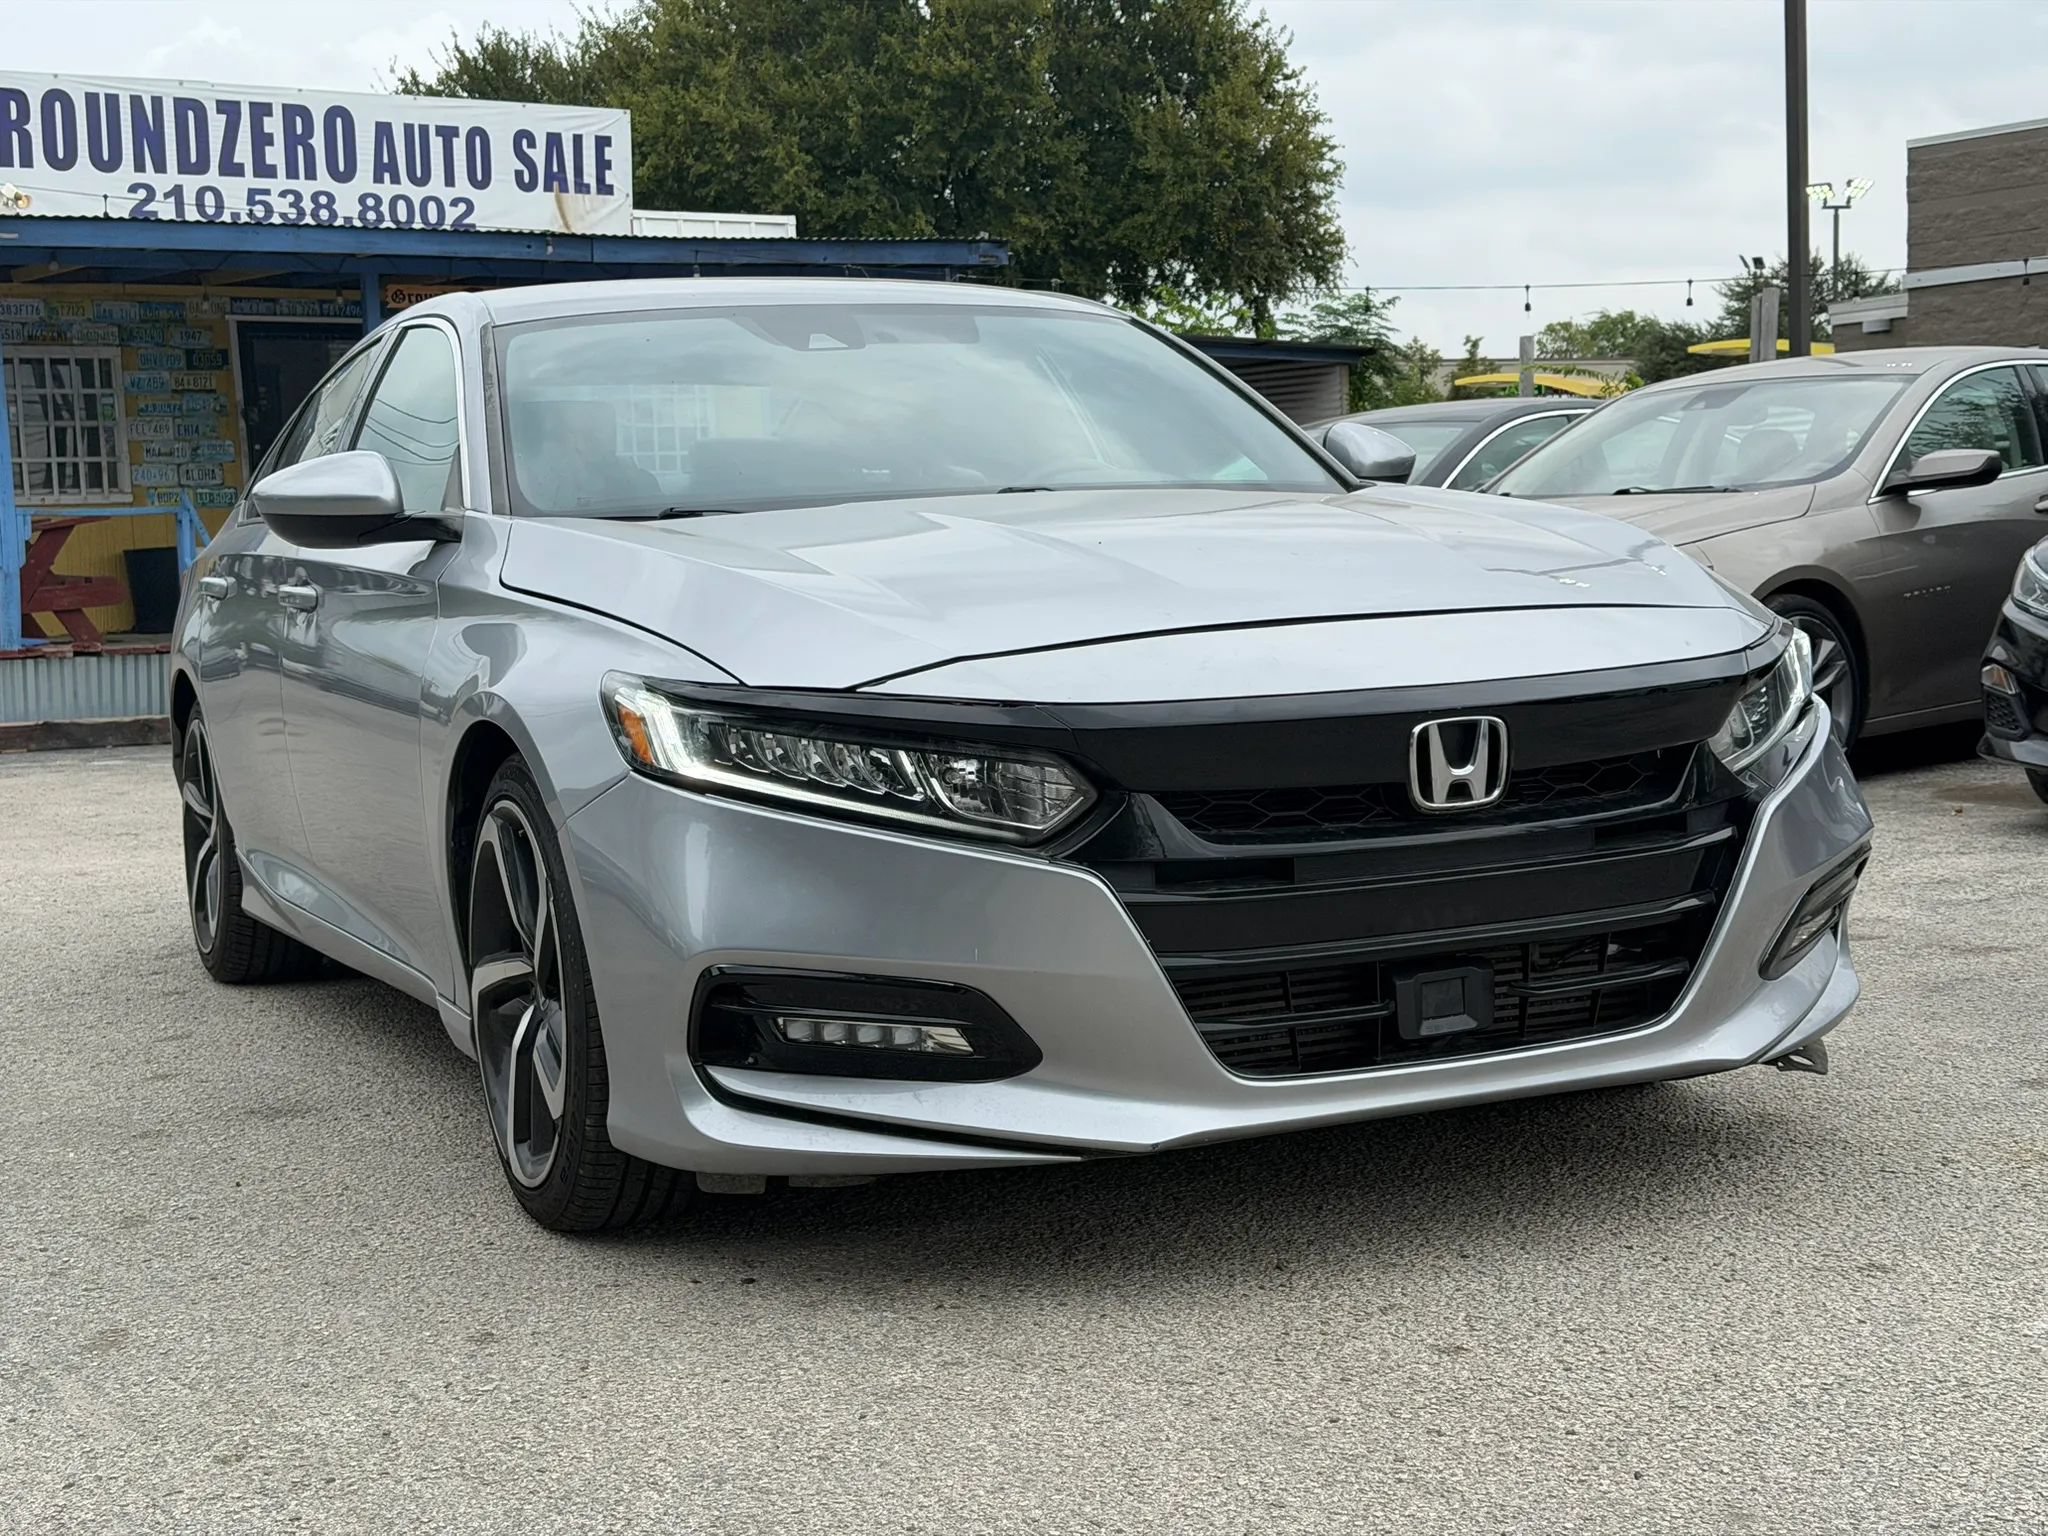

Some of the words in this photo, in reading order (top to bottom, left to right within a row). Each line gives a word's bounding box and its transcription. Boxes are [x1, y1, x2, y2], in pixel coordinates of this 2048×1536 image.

[0, 86, 357, 185] ROUNDZERO
[373, 121, 492, 190] AUTO
[513, 129, 614, 196] SALE
[127, 182, 476, 229] 210.538.8002
[185, 469, 217, 481] ALOHA
